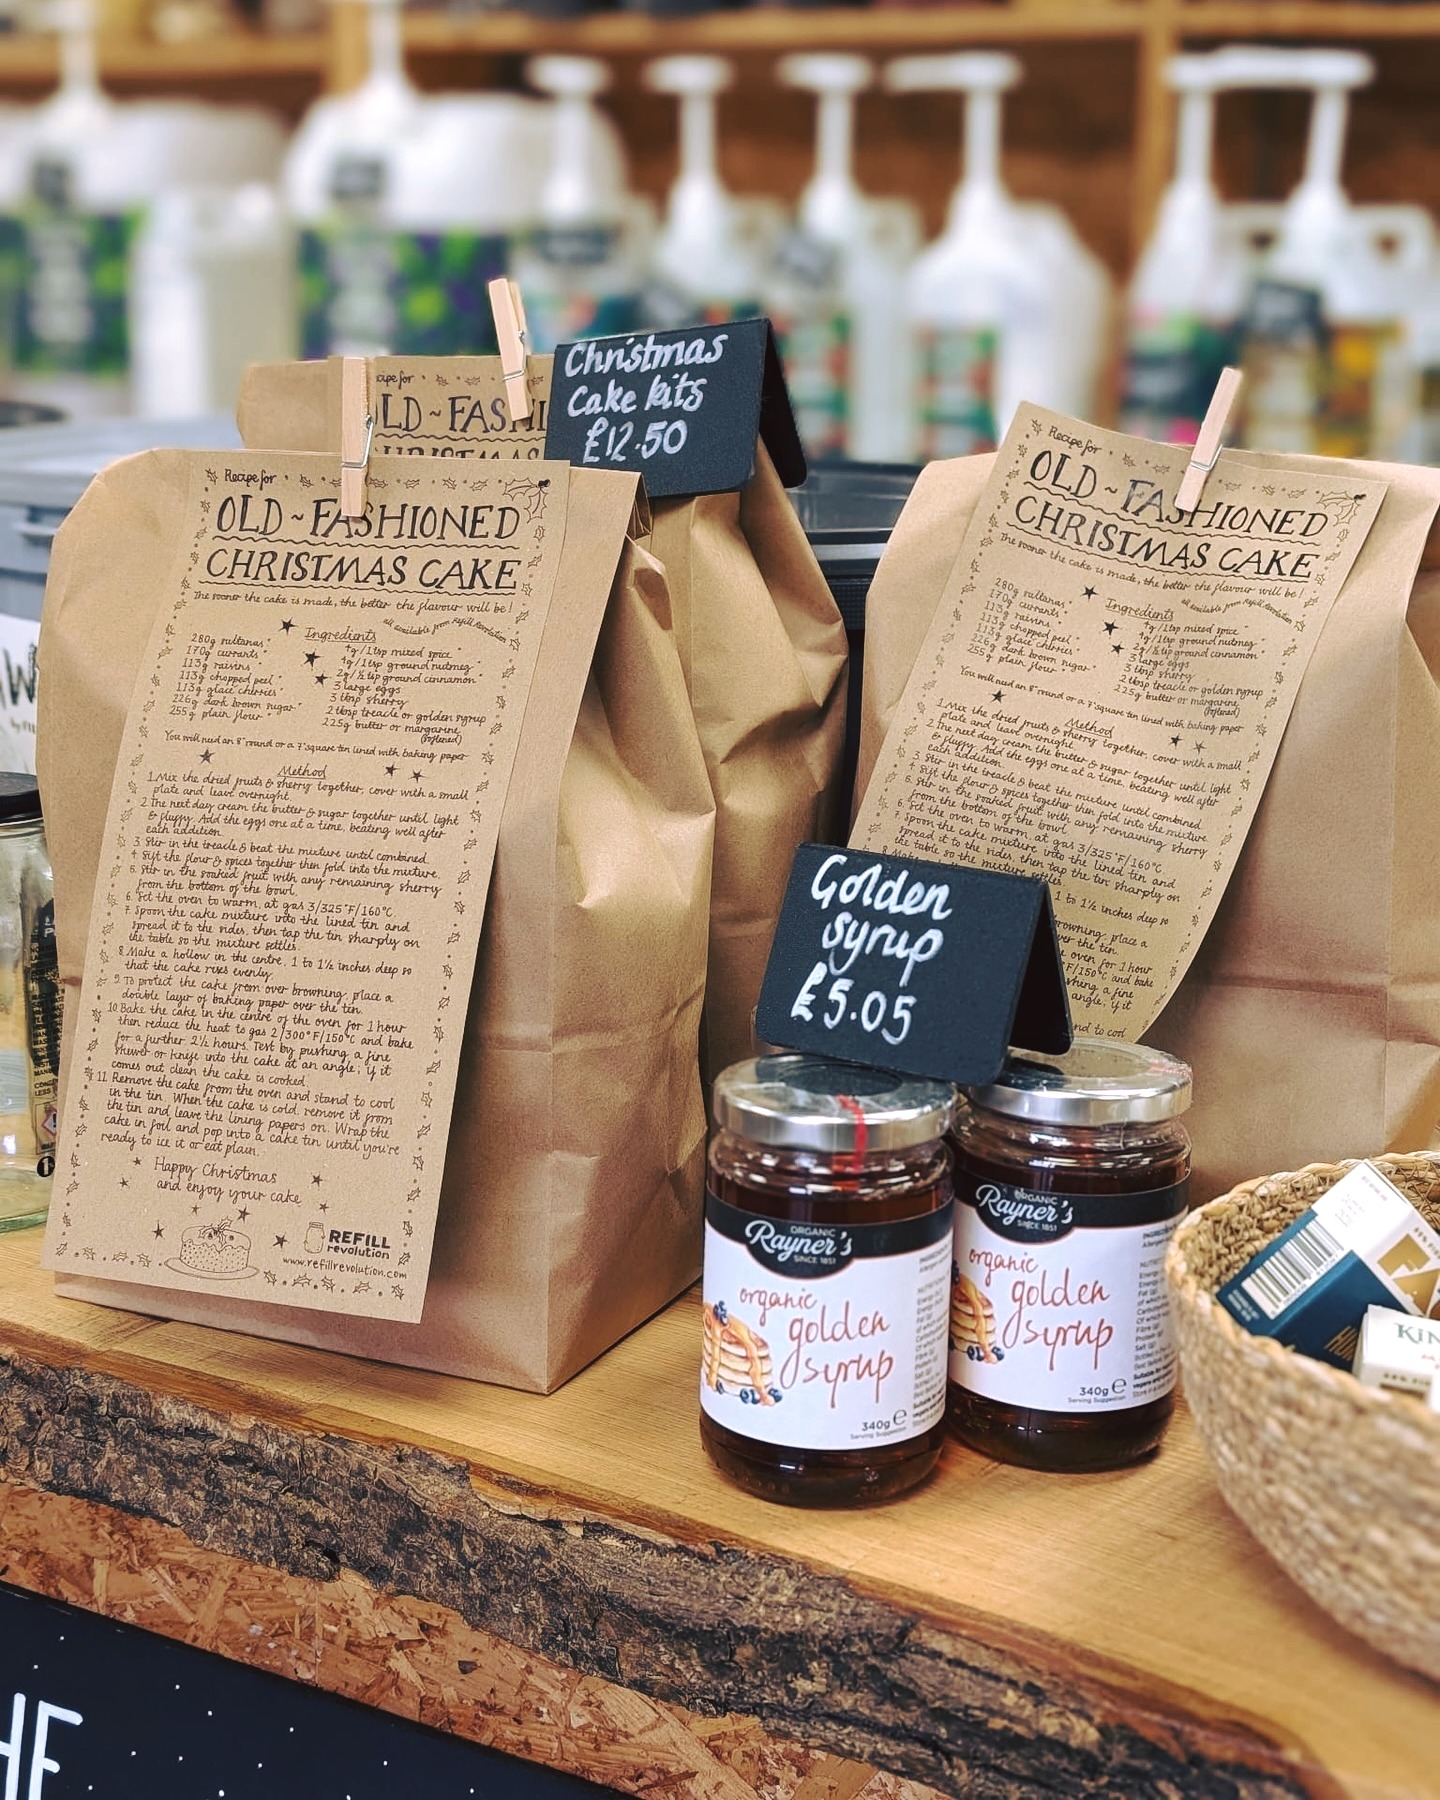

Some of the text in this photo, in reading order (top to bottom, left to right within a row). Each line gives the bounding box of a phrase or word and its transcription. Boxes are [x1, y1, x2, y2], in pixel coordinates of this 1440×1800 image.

[565, 334, 728, 377] Christmas
[398, 371, 414, 390] for
[376, 394, 421, 431] LD
[567, 379, 637, 417] Cake
[582, 416, 688, 464] £12.50
[1048, 425, 1103, 457] Recipe for
[223, 467, 277, 491] Recipe for
[1029, 449, 1098, 499] OLD
[216, 493, 283, 536] OLD
[1015, 496, 1316, 579] CHRISTMAS CAKE
[205, 547, 522, 590] CHRISTMAS CAKE
[193, 590, 513, 616] The sooner the cake is made, the better the flavour will be!
[1104, 596, 1174, 622] Ingredients
[303, 624, 377, 644] Ingredients
[328, 692, 337, 702] 3
[365, 692, 409, 710] sherry
[332, 680, 401, 698] 3 large eggs
[324, 704, 333, 715] 2
[360, 706, 399, 718] treacle
[400, 711, 413, 719] or
[415, 709, 453, 725] golden
[455, 713, 487, 727] syrup
[1063, 717, 1115, 737] Method
[276, 762, 328, 780] Method
[151, 782, 179, 798] plate
[182, 784, 204, 796] and
[208, 785, 236, 797] leave
[811, 854, 952, 920] Golden
[119, 1002, 407, 1035] Bake the cake in the centre of the oven for 1 hour
[791, 961, 918, 1045] £5.05
[117, 1013, 414, 1050] then reduce the heat to gas and bake
[111, 1070, 395, 1110] Remove the cake from the oven and stand to cool
[99, 1129, 260, 1158] ready to ice it or eat plain.
[103, 1112, 400, 1160] cake in foil and pop into a cake tin until you're
[153, 1155, 277, 1184] Happy Christmas
[155, 1173, 302, 1205] and enjoy your cake
[976, 1185, 1073, 1225] Rayner's
[328, 1228, 391, 1249] REFILL
[745, 1220, 852, 1262] Rayner's
[790, 1225, 836, 1237] ORGANIC
[282, 1257, 407, 1279] www.refillrevolution.com
[326, 1244, 390, 1260] revolution
[969, 1249, 1038, 1287] organic
[739, 1287, 817, 1327] organic
[1003, 1268, 1110, 1348] golden
[780, 1301, 889, 1389] golden
[1023, 1318, 1113, 1370] syrup
[803, 1350, 894, 1408] syrup
[1080, 1386, 1108, 1396] 340g
[862, 1420, 890, 1431] 340g
